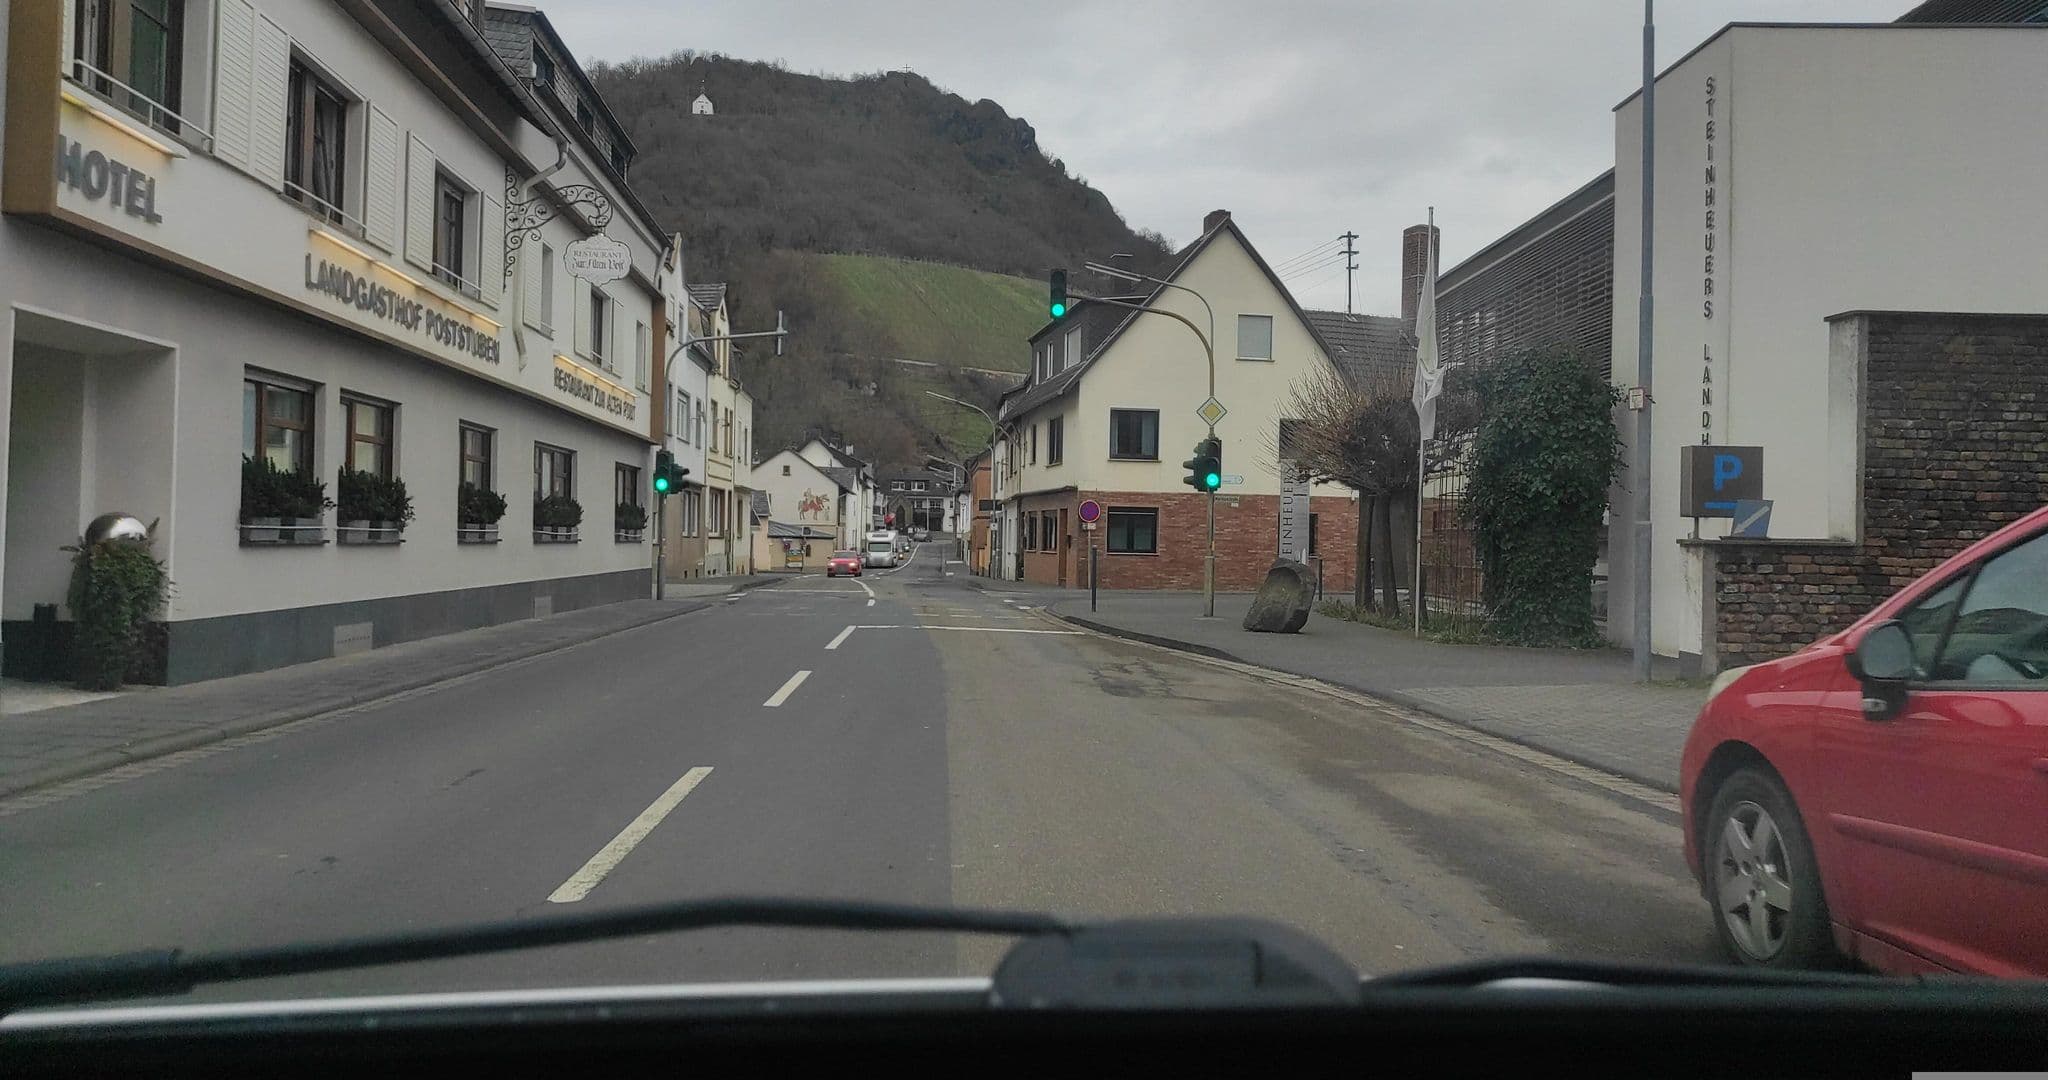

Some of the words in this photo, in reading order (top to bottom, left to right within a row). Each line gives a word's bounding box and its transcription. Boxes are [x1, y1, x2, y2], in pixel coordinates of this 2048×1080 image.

[57, 134, 163, 225] HOTEL
[1704, 76, 1715, 320] STEINHEUERS
[305, 253, 423, 332] LANDGASTHOF
[426, 309, 500, 365] POSTSTUBEN
[554, 366, 594, 402] RESTAURANT
[594, 387, 606, 409] ZUR
[1713, 454, 1743, 491] P
